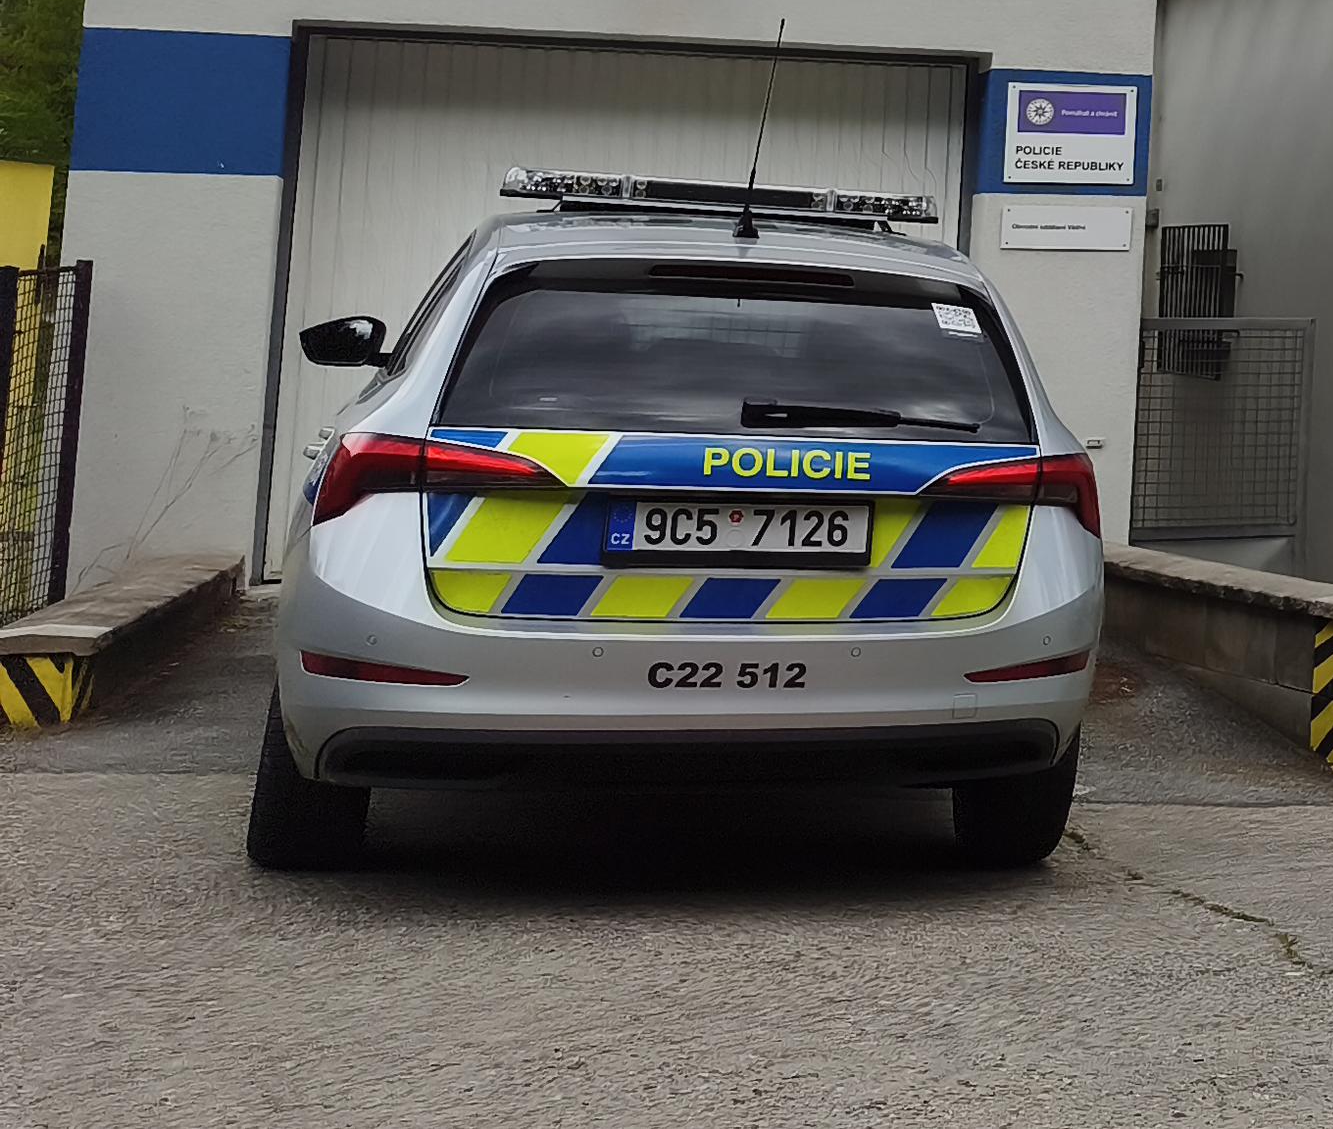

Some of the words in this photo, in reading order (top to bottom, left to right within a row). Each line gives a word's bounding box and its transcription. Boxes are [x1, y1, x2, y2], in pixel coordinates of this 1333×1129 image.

[1015, 146, 1062, 156] POLICIE
[1014, 158, 1055, 171] ČESKÉ
[1058, 161, 1124, 171] REPUBLIKY
[703, 447, 872, 481] POLICIE
[643, 507, 720, 546] 9C5
[751, 509, 850, 548] 7126
[610, 533, 630, 546] CZ
[647, 662, 723, 689] C22
[736, 662, 807, 689] 512
